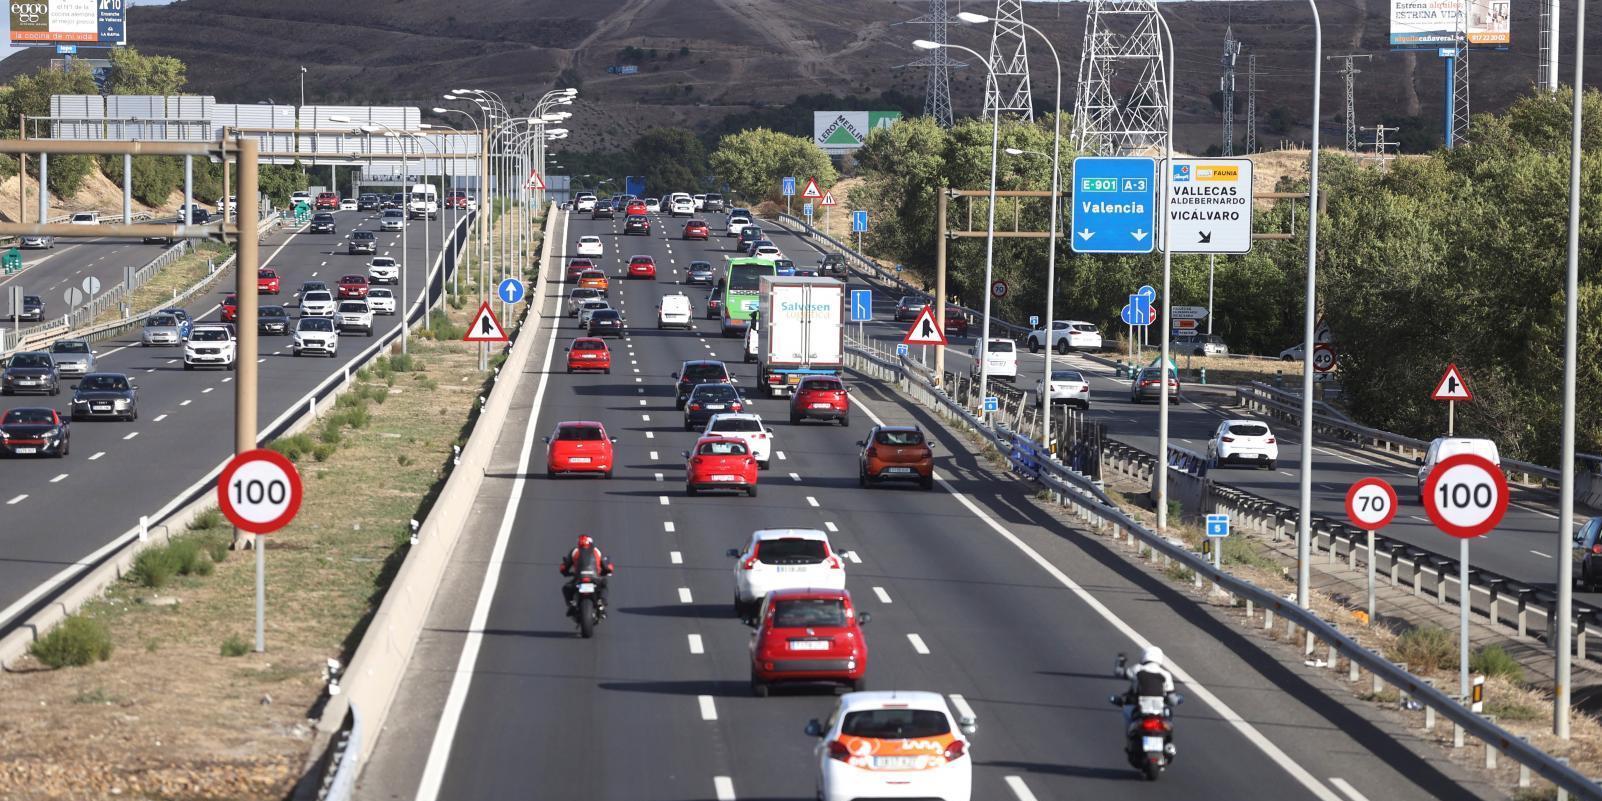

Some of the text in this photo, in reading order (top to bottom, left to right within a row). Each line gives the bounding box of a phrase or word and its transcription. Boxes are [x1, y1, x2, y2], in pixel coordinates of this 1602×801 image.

[11, 3, 48, 22] eggo
[1395, 10, 1463, 19] ESTRENA VIDA
[817, 119, 841, 143] LEROY
[837, 114, 866, 142] MERLIN
[1083, 180, 1146, 190] E-901 A-3
[1173, 186, 1237, 196] VALLECAS
[1082, 201, 1145, 214] Valencia
[1170, 197, 1246, 205] ALDEBERNARDO
[1170, 208, 1240, 221] VICÁLVARO
[780, 301, 831, 312] Salvesen
[1314, 354, 1331, 363] 40
[233, 479, 286, 504] 100
[1439, 483, 1492, 508] 100
[1358, 496, 1385, 512] 70
